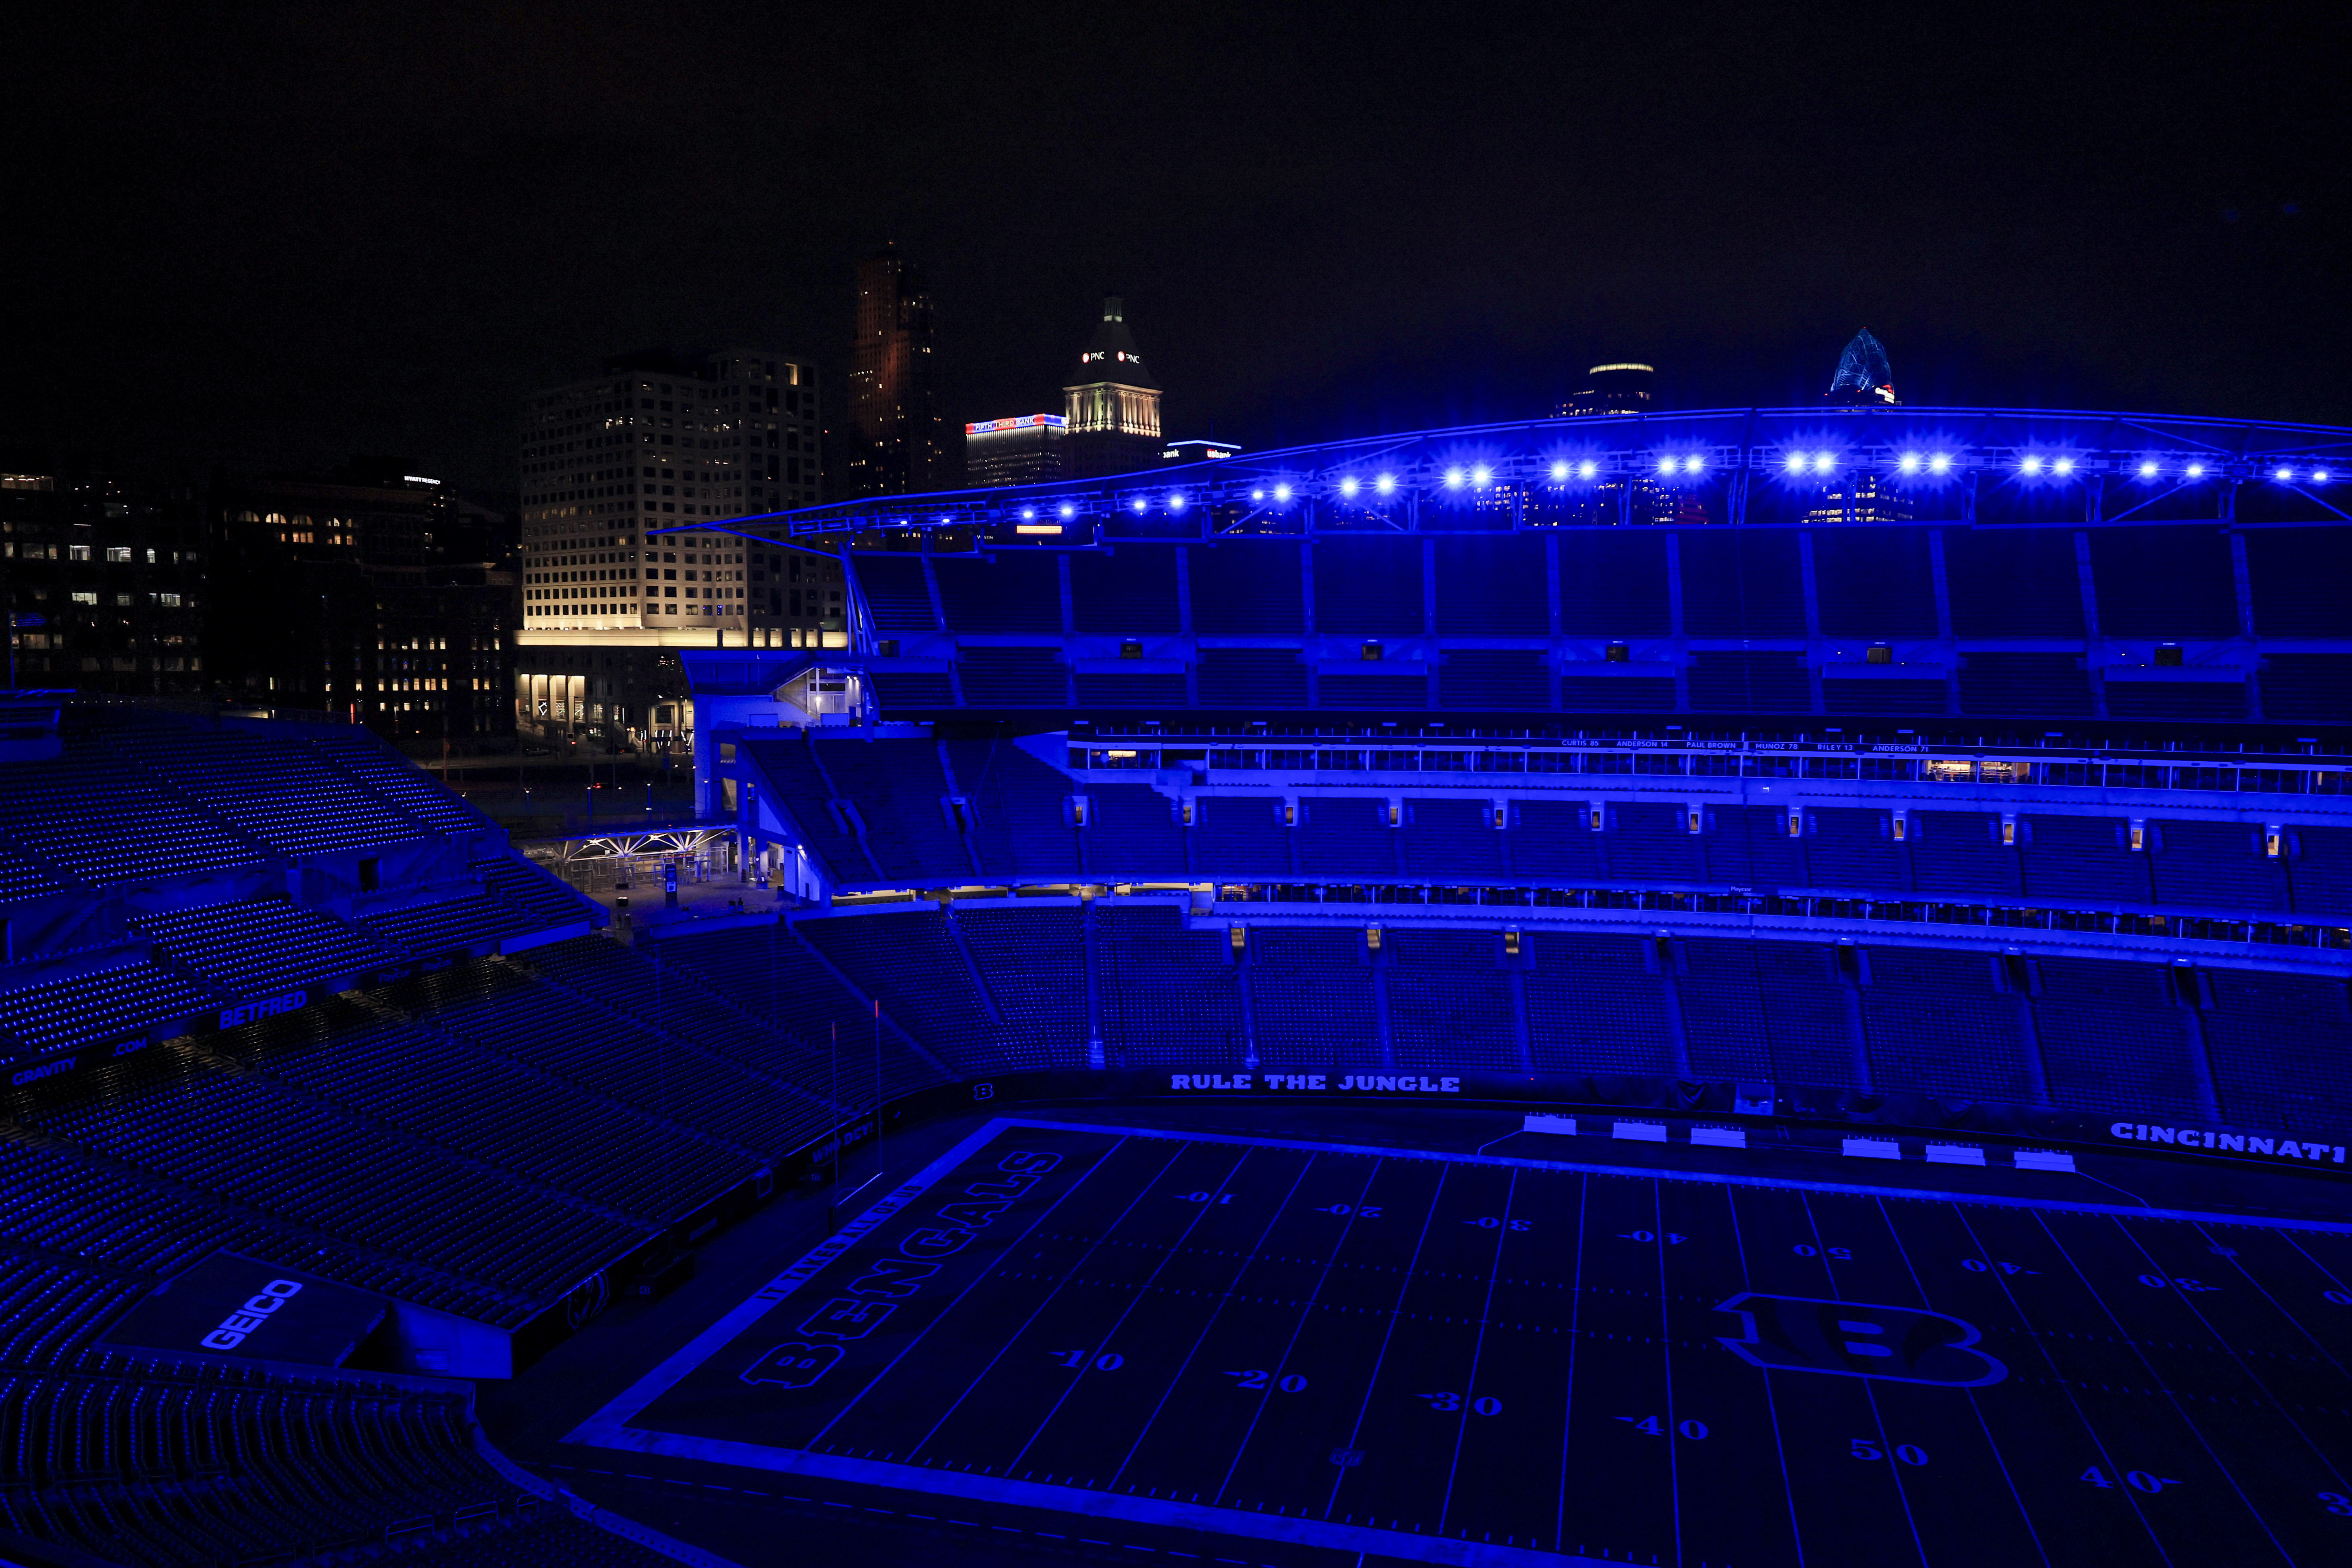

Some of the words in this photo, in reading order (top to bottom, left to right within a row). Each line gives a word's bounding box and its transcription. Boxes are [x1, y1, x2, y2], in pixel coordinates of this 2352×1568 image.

[1090, 351, 1105, 361] PNC
[1126, 353, 1140, 364] PNC
[995, 420, 1014, 428] THIRD
[1015, 417, 1034, 425] BANK
[219, 990, 307, 1030] BETFRED
[11, 1057, 77, 1086] GRAVITY
[112, 1036, 147, 1057] .COM
[1170, 1073, 1252, 1090] RULE
[1264, 1074, 1327, 1090] THE
[1337, 1075, 1460, 1092] JUNGLE
[811, 1137, 841, 1164] WHO
[844, 1120, 874, 1146] DEY!
[2110, 1122, 2346, 1164] CINCINNATI
[1188, 1190, 1239, 1206] 10
[1328, 1203, 1384, 1219] 20
[1476, 1216, 1533, 1232] 30
[755, 1286, 788, 1300] IT
[780, 1243, 847, 1280] TAKES
[840, 1219, 880, 1238] ALL
[872, 1201, 899, 1214] OF
[893, 1185, 923, 1198] US
[1632, 1229, 1688, 1246] 40
[1793, 1244, 1853, 1261] 50
[738, 1151, 1064, 1390] BENGALS
[1961, 1258, 2023, 1275] 40
[2138, 1274, 2206, 1293] 30
[200, 1279, 303, 1350] GEICO
[1059, 1350, 1125, 1372] 10
[1236, 1370, 1308, 1393] 20
[1429, 1391, 1503, 1416] 30
[1635, 1414, 1710, 1442] 40
[1850, 1439, 1930, 1467] 50
[2079, 1465, 2164, 1494] 40
[2318, 1491, 2352, 1517] 3
